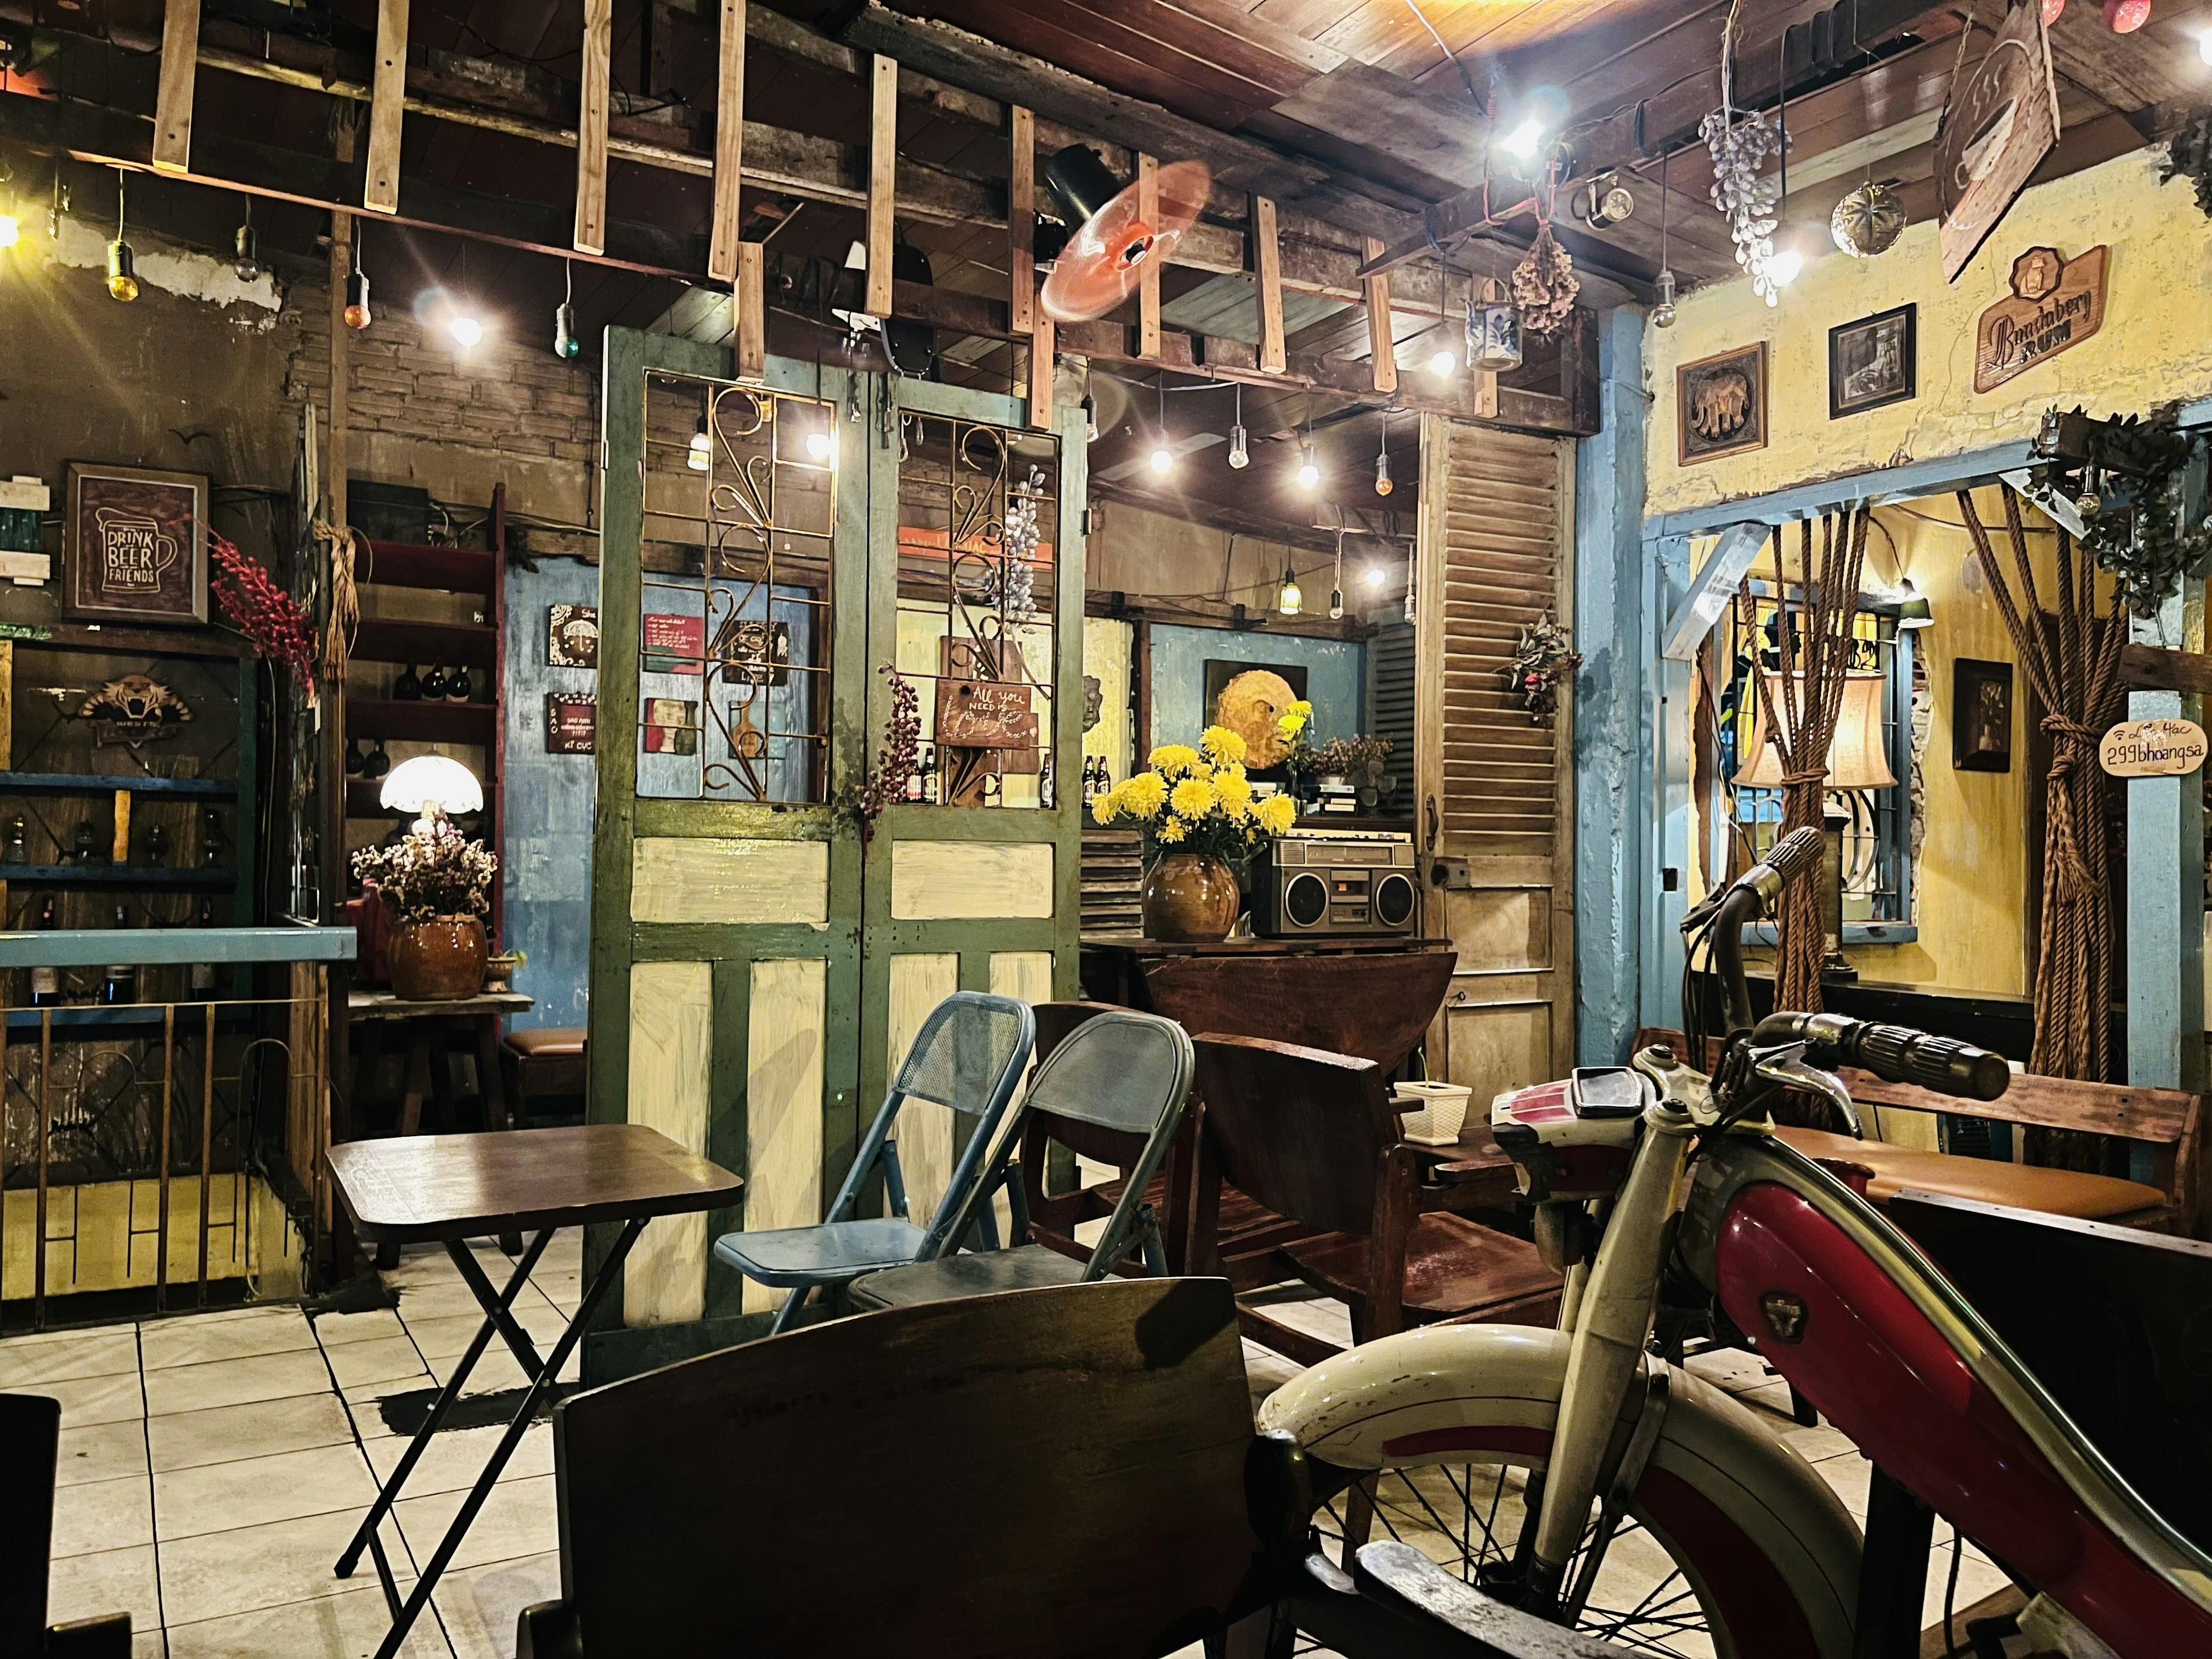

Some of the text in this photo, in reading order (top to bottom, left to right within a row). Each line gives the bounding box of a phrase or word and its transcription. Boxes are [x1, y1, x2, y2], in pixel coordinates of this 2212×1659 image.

[2020, 319, 2072, 364] RUM
[108, 532, 154, 550] DRINK
[108, 546, 153, 568] BEER
[110, 568, 154, 583] FRIENDS
[973, 686, 1025, 704] All you
[969, 702, 995, 711] NEED
[2107, 743, 2204, 769] 299bhoangsa
